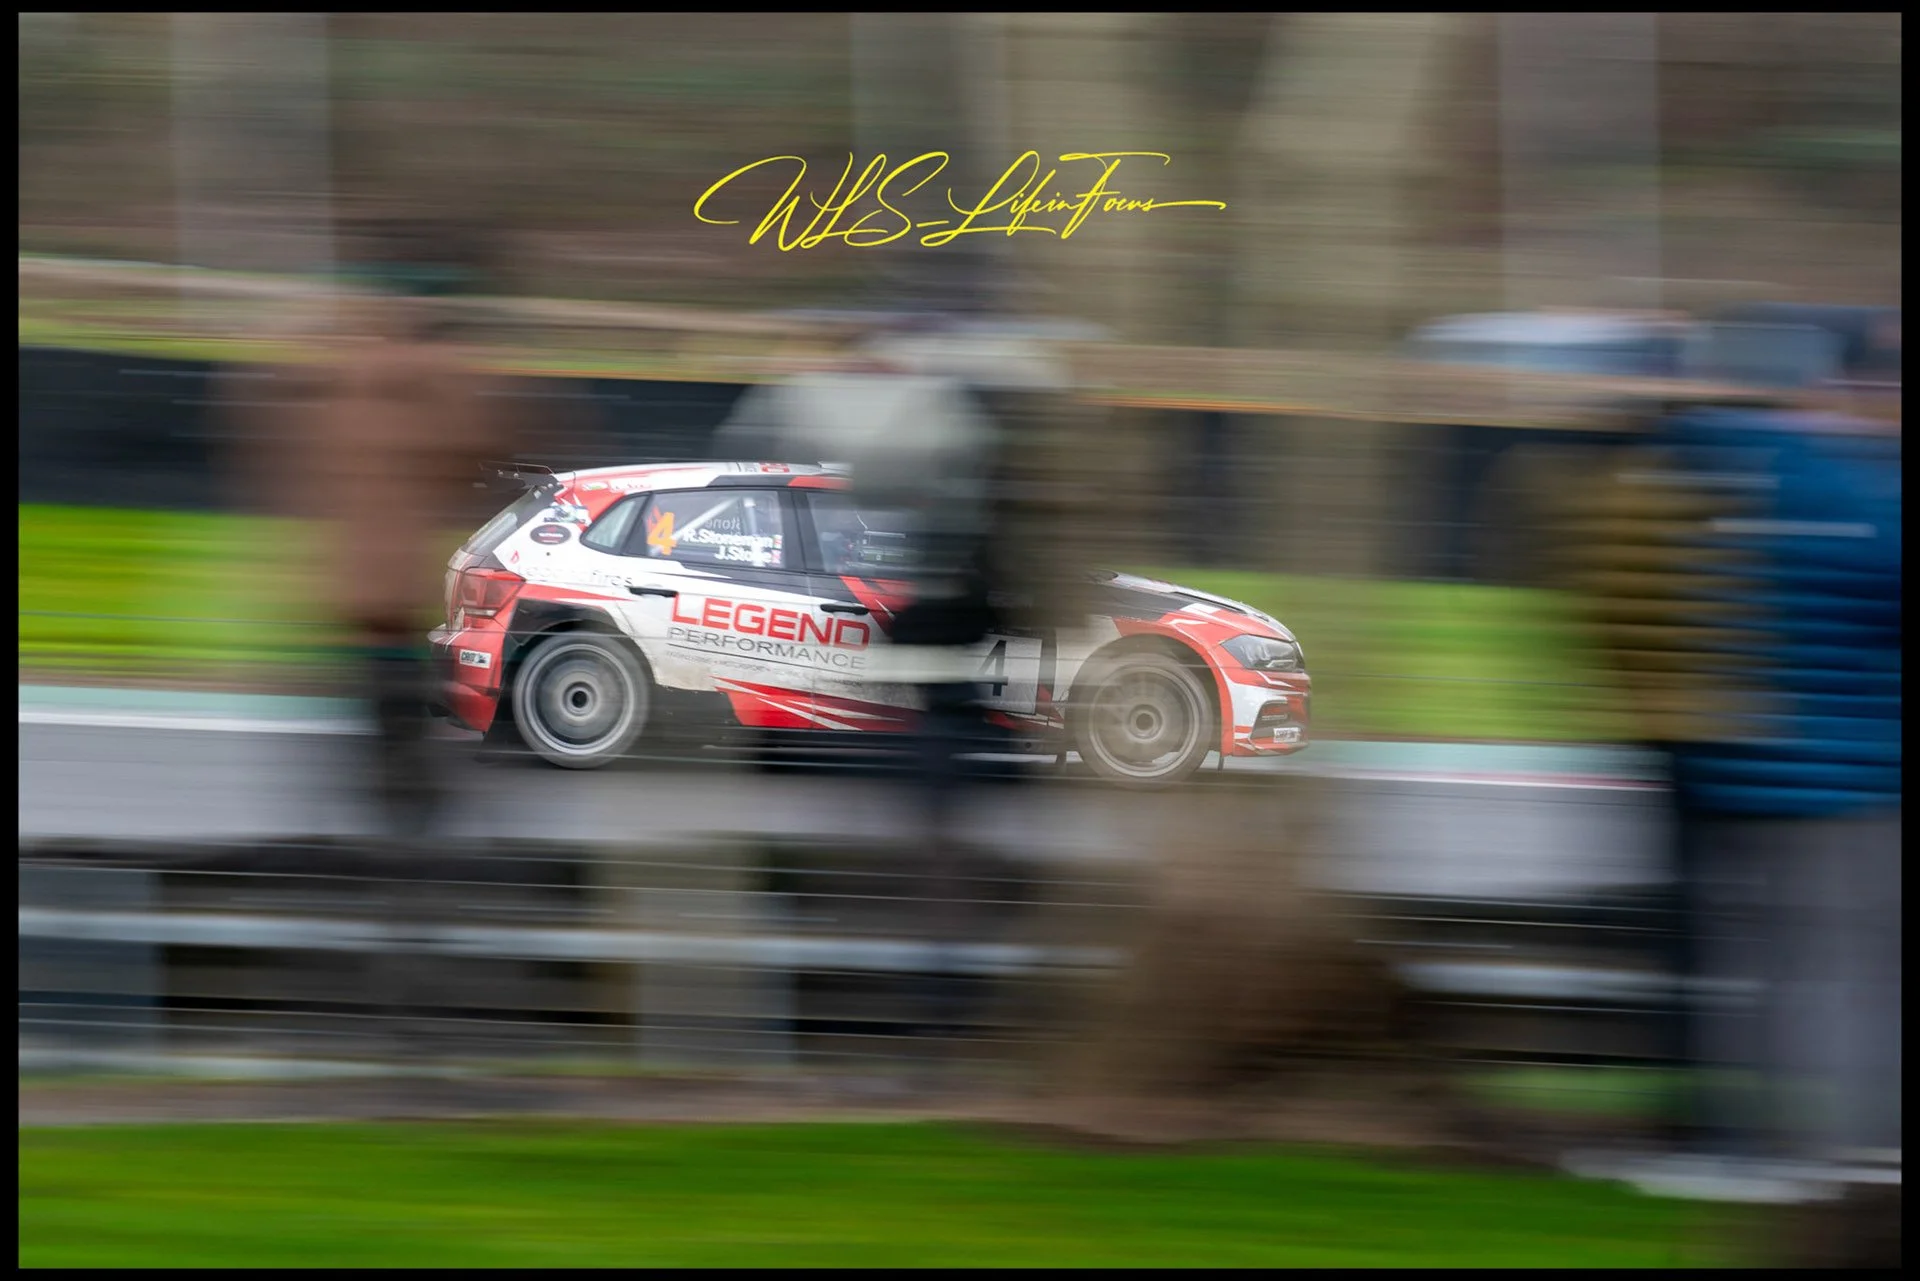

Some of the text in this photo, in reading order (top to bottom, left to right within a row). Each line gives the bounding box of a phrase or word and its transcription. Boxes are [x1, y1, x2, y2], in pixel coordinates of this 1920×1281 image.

[647, 511, 677, 555] 4
[714, 545, 772, 563] J.Stoe
[671, 592, 871, 651] LEGEND
[666, 626, 866, 670] PERFORMANCE
[976, 639, 1009, 697] 4
